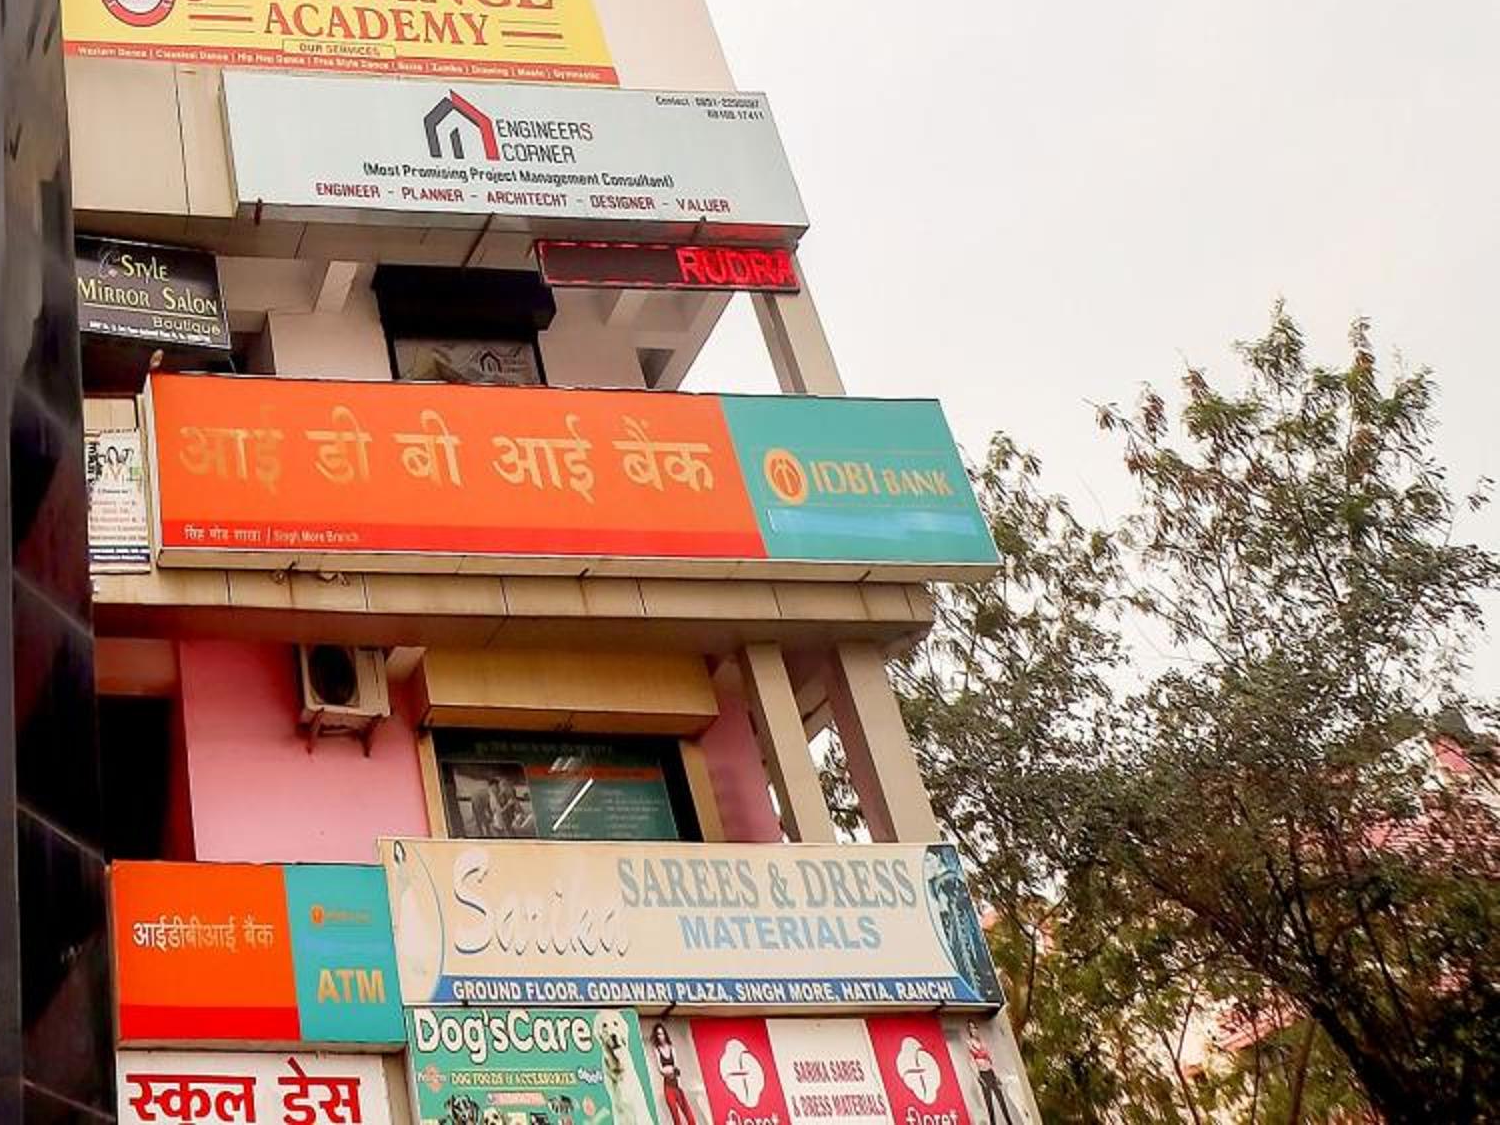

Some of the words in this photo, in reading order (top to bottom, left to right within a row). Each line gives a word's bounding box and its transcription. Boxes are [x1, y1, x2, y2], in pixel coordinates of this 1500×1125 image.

[263, 2, 489, 46] ACADEMY
[117, 47, 147, 58] Dance
[299, 42, 323, 55] OUR
[325, 43, 380, 57] SERVICES
[495, 118, 593, 141] ENGINEERS
[501, 142, 577, 164] CORNER
[363, 162, 400, 176] (Most
[402, 164, 468, 183] Promising
[469, 166, 518, 184] Project
[519, 169, 599, 187] Management
[601, 172, 675, 188] Consultant)
[315, 182, 381, 199] ENGINEER
[401, 186, 465, 203] PLANNER
[487, 189, 568, 207] ARCHITECHT
[590, 194, 656, 211] DESIGNER
[675, 197, 731, 213] VALUER
[151, 316, 221, 336] Boutique
[304, 405, 373, 484] डी
[394, 408, 464, 488] बी
[490, 412, 597, 505] आई
[611, 413, 715, 493] बैंक
[808, 460, 881, 495] IDBI
[883, 467, 954, 497] BANK
[616, 857, 760, 909] SAREES
[767, 860, 797, 910] &
[795, 857, 918, 910] DRESS
[133, 914, 237, 953] आईडीबीआई
[242, 911, 275, 946] बैंक
[675, 913, 883, 951] MATERIALS
[316, 968, 386, 1004] ATM
[452, 979, 522, 1001] GROUND
[526, 980, 585, 1002] FLOOR,
[587, 981, 672, 1002] GODAWARI
[676, 981, 733, 1003] PLAZA,
[737, 981, 785, 1002] SINGH
[788, 981, 842, 1003] MORE,
[842, 981, 894, 1003] HATIA,
[896, 980, 956, 1001] RANCHI
[451, 1072, 472, 1085] DOG
[802, 1095, 833, 1117] DRESS
[833, 1094, 887, 1117] MATERIALS
